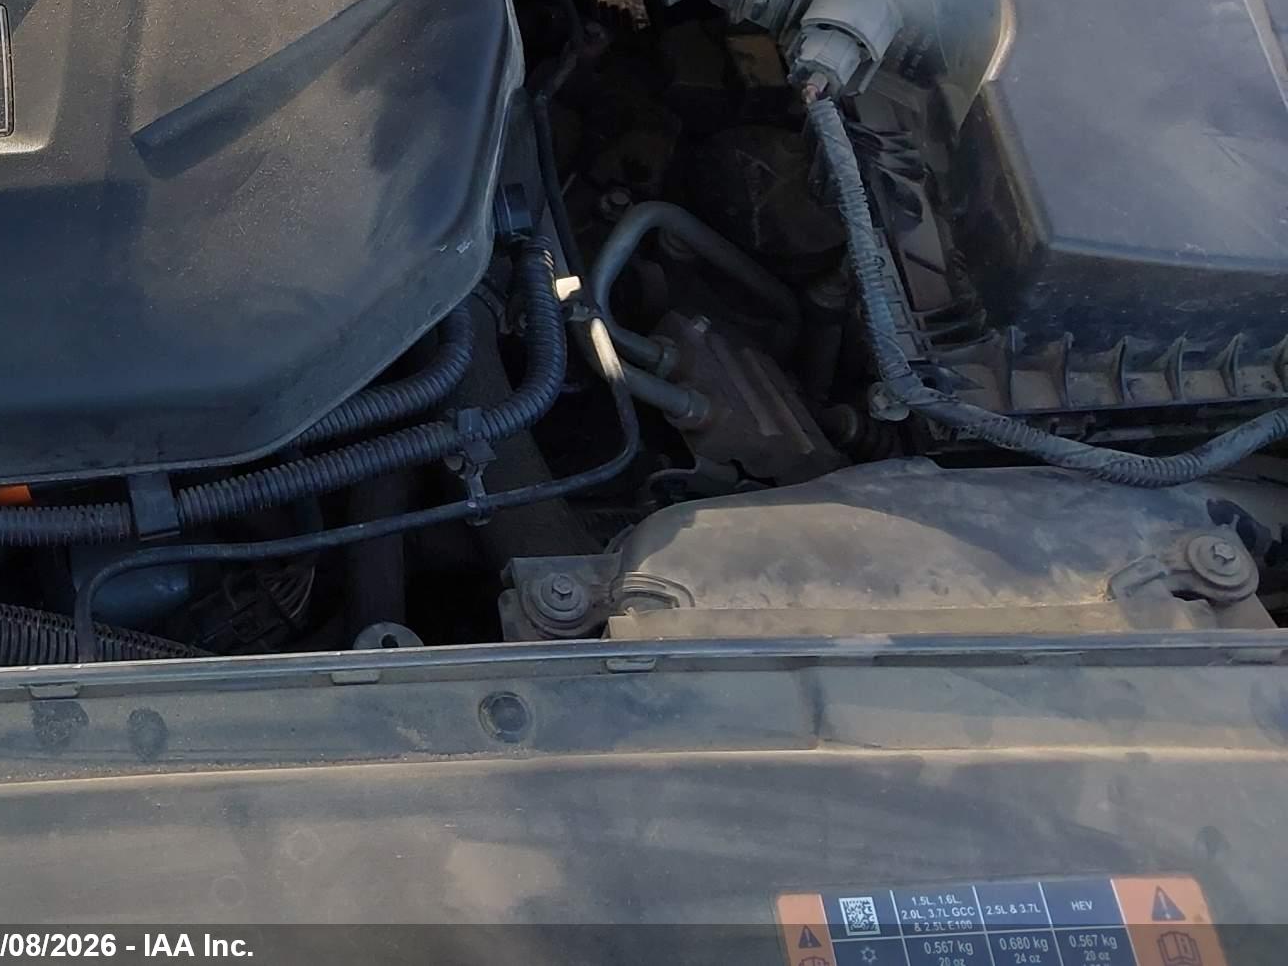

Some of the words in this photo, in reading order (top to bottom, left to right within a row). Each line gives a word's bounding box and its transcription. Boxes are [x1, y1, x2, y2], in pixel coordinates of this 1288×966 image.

[986, 905, 1008, 915] 2.5L
[1009, 904, 1018, 914] &
[1019, 903, 1041, 913] 3.7L
[1072, 900, 1093, 911] HEV
[952, 906, 976, 917] GCC
[915, 922, 922, 932] &
[999, 936, 1031, 951] 0.680
[1033, 937, 1049, 952] kg
[1069, 934, 1099, 948] 0.567
[1101, 934, 1118, 949] kg
[924, 940, 954, 955] 0.567
[957, 940, 974, 956] kg
[953, 958, 966, 966] oz
[1015, 953, 1027, 964] 24
[1029, 954, 1041, 963] oz
[1098, 952, 1111, 961] oz
